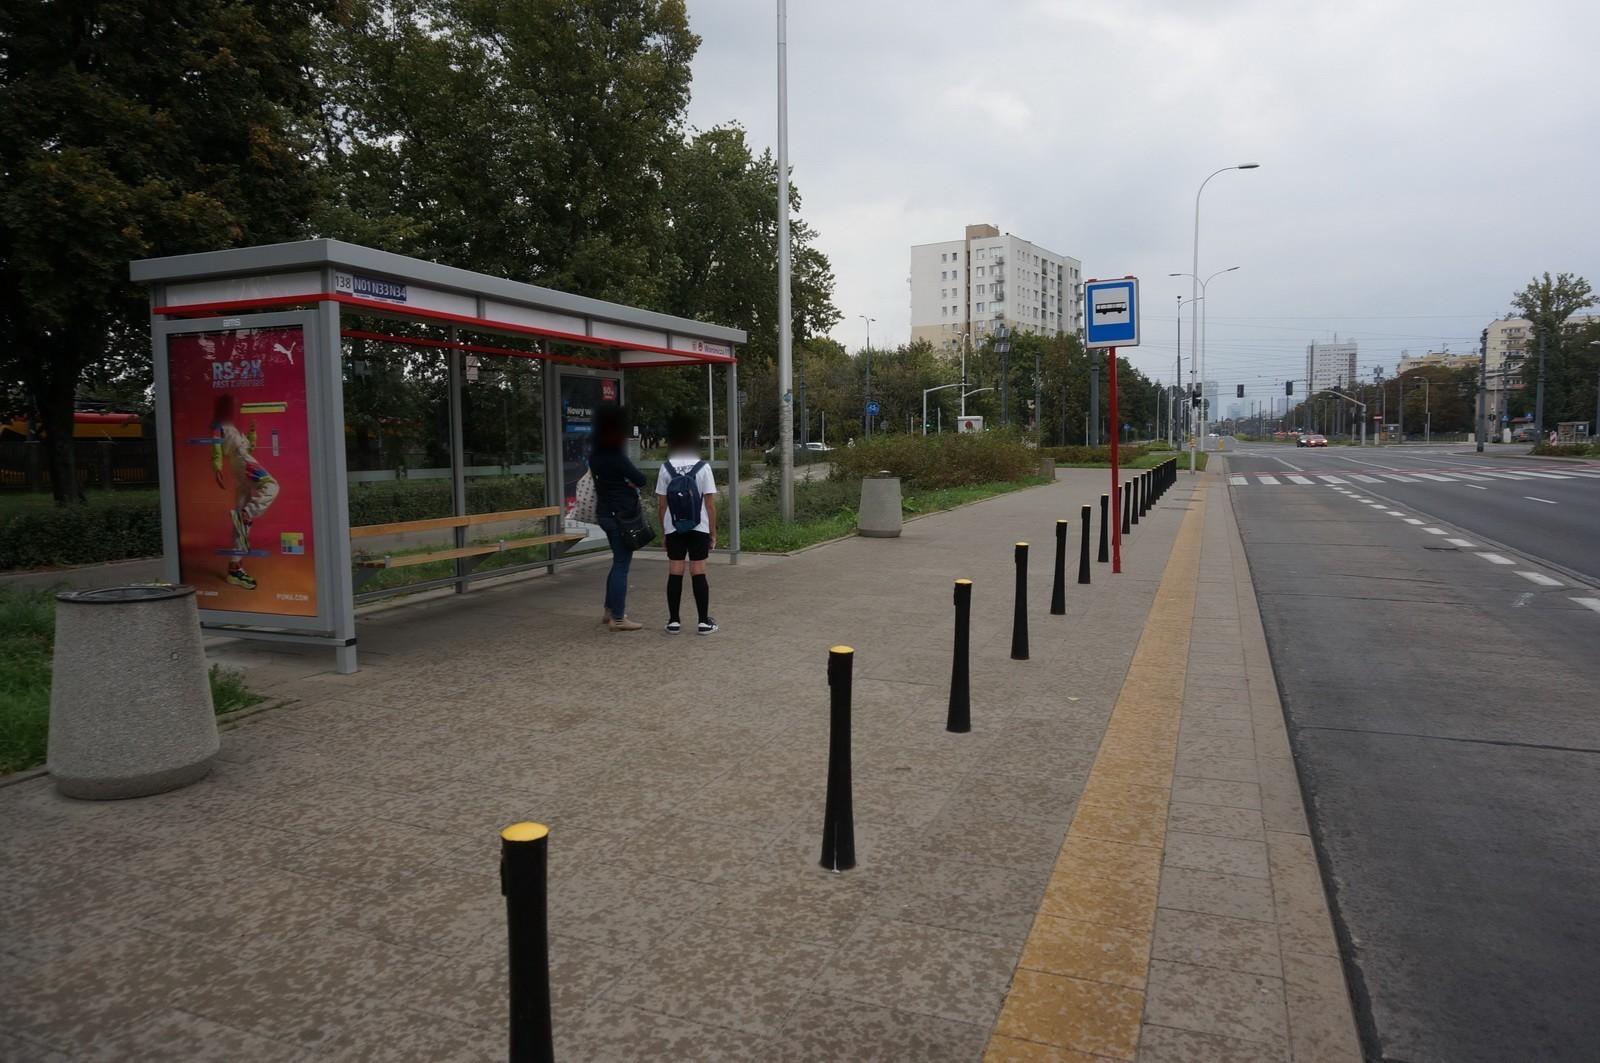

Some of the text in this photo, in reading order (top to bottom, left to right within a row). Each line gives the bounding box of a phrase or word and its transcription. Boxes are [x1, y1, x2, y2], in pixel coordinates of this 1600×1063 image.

[336, 276, 406, 298] 138 N01 N33 N34
[567, 406, 584, 416] Nowy
